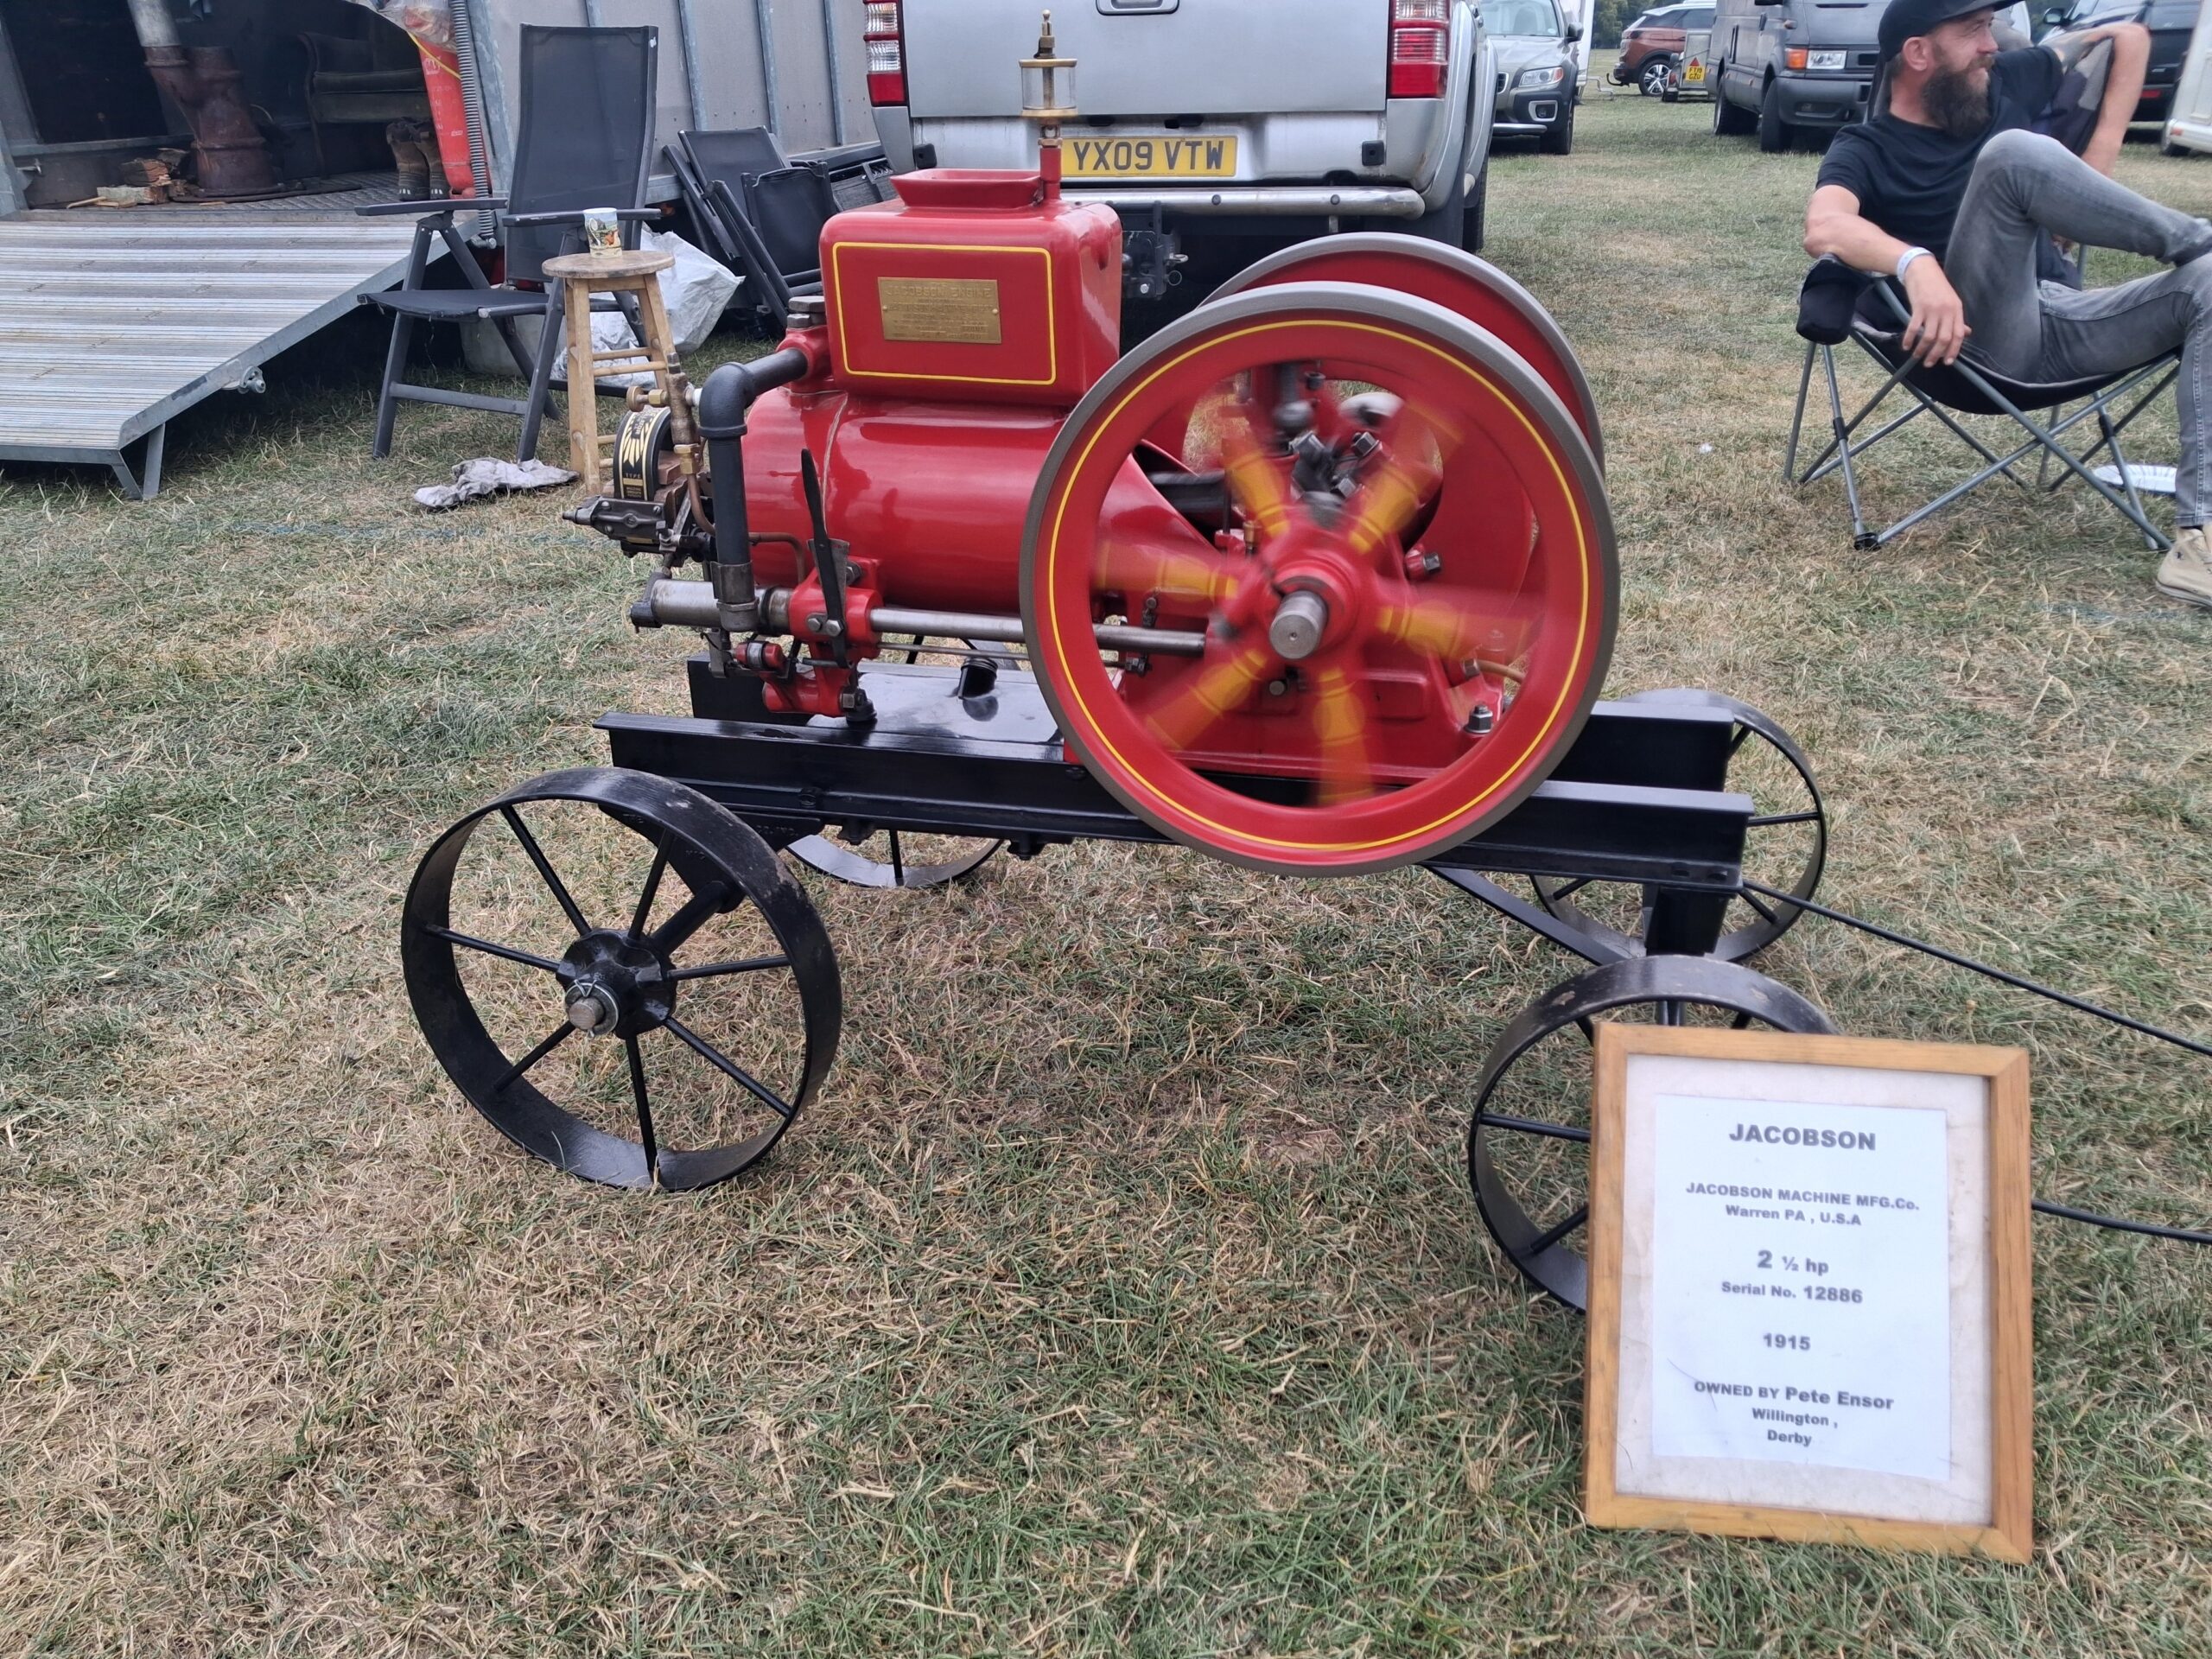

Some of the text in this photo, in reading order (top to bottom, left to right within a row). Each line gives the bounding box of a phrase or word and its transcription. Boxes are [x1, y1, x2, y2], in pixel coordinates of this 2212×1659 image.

[1073, 140, 1224, 171] YX09 VTW
[1729, 1123, 1876, 1151] JACOBSON
[1686, 1182, 1920, 1211] JACOBSON MACHINE MFG.Co.
[1725, 1205, 1780, 1219] Warren
[1785, 1209, 1806, 1221] PA
[1820, 1212, 1862, 1225] U.S.A
[1758, 1249, 1829, 1276] 2 ½ hp
[1721, 1281, 1863, 1303] Serial No. 12886
[1763, 1333, 1811, 1351] 1915
[1694, 1382, 1895, 1409] OWNED BY Pete Ensor
[1751, 1408, 1830, 1427] Willington
[1767, 1429, 1813, 1447] Derby
